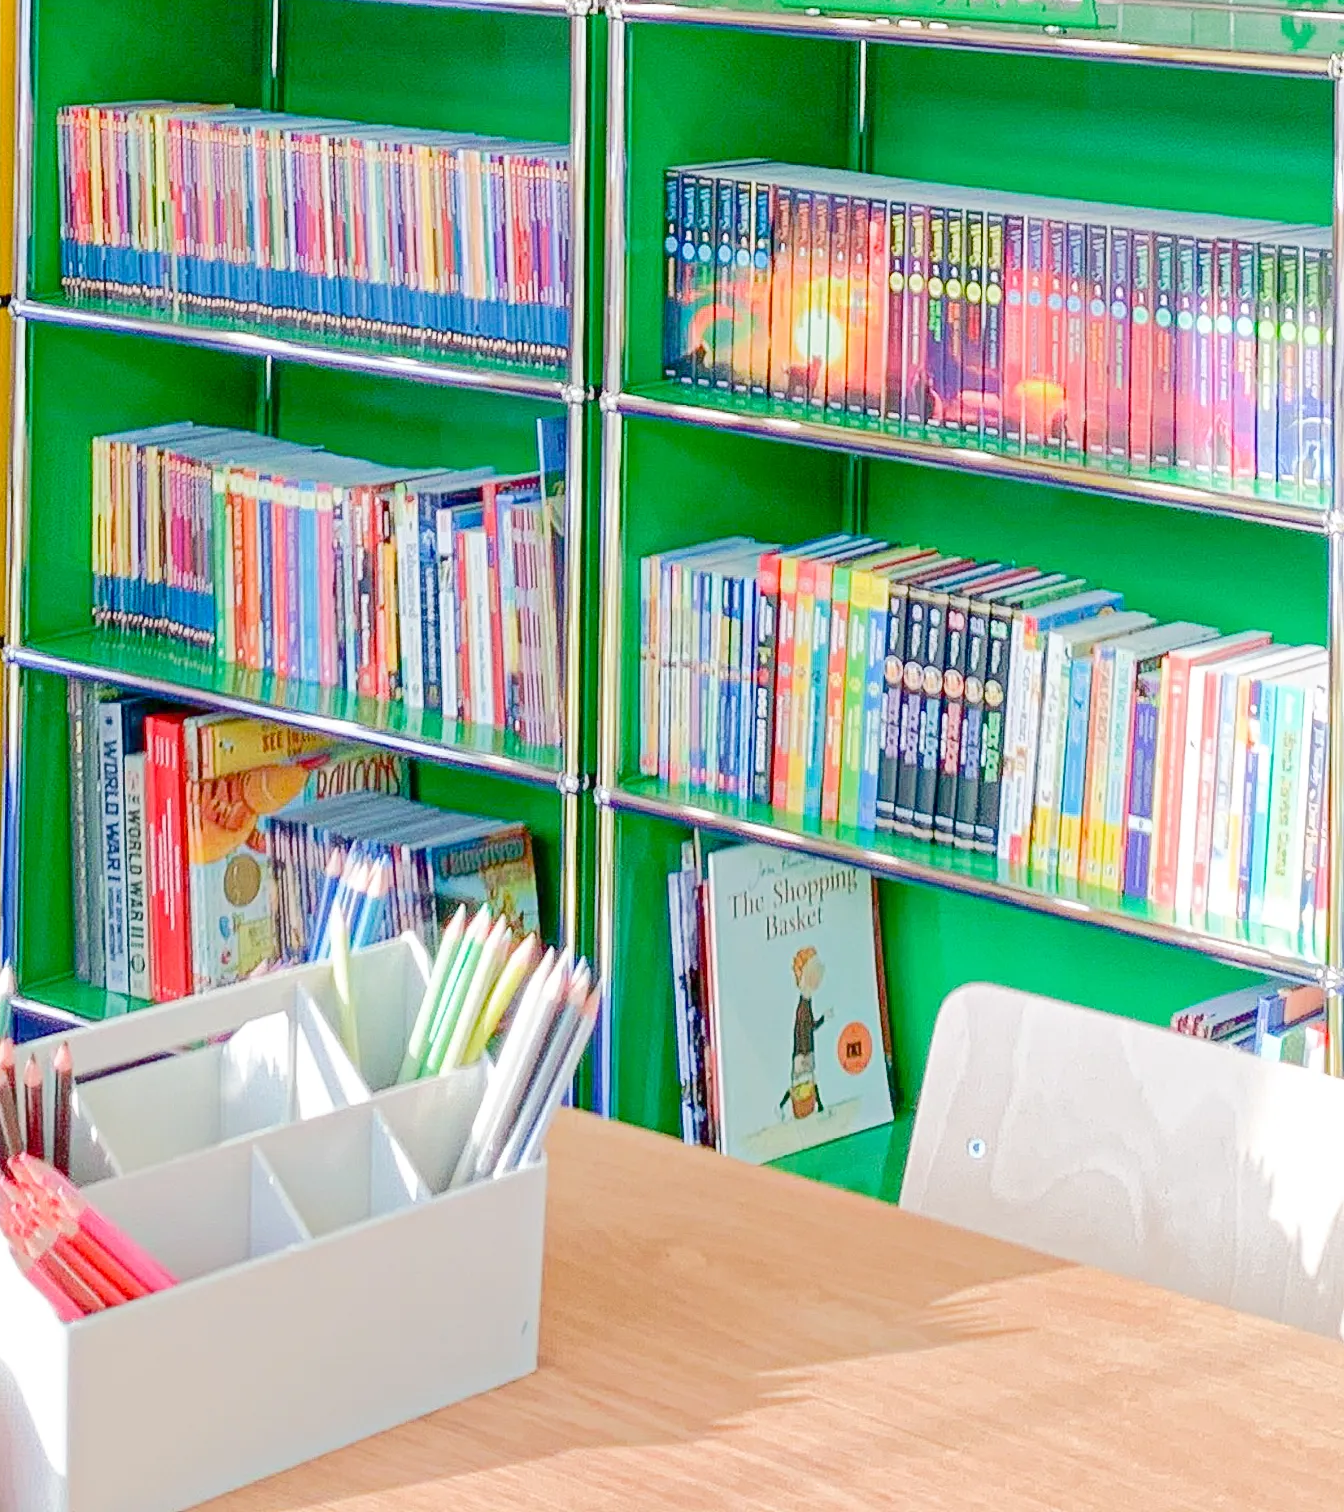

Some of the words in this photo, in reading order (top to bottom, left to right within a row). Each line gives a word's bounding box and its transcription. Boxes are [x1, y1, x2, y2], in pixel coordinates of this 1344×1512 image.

[103, 739, 120, 818] WORLD
[106, 821, 121, 875] WAR
[127, 808, 143, 877] WORLD
[128, 878, 144, 923] WAR
[729, 892, 765, 921] The
[772, 866, 859, 906] Shopping
[765, 904, 825, 941] Basket
